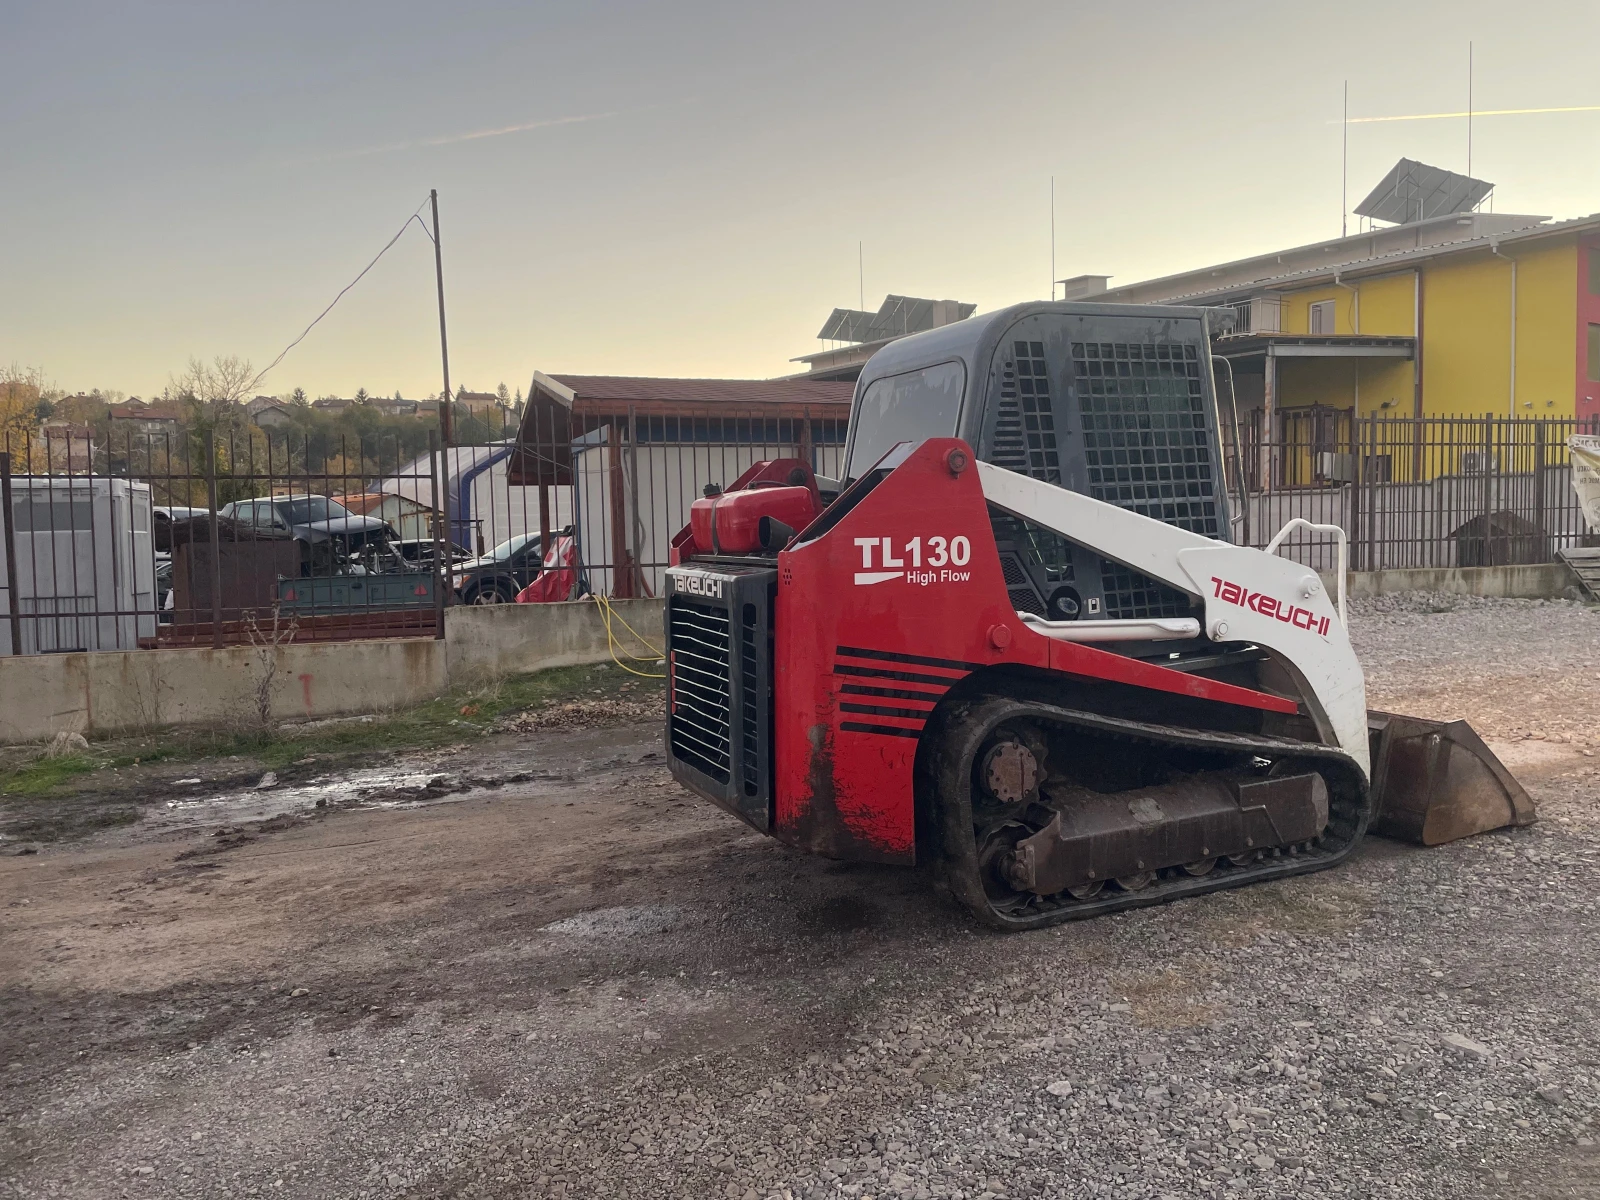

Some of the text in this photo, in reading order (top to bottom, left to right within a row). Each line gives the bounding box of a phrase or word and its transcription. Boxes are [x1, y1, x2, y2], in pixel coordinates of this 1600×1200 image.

[854, 536, 971, 569] TL130
[907, 570, 971, 587] High Flow
